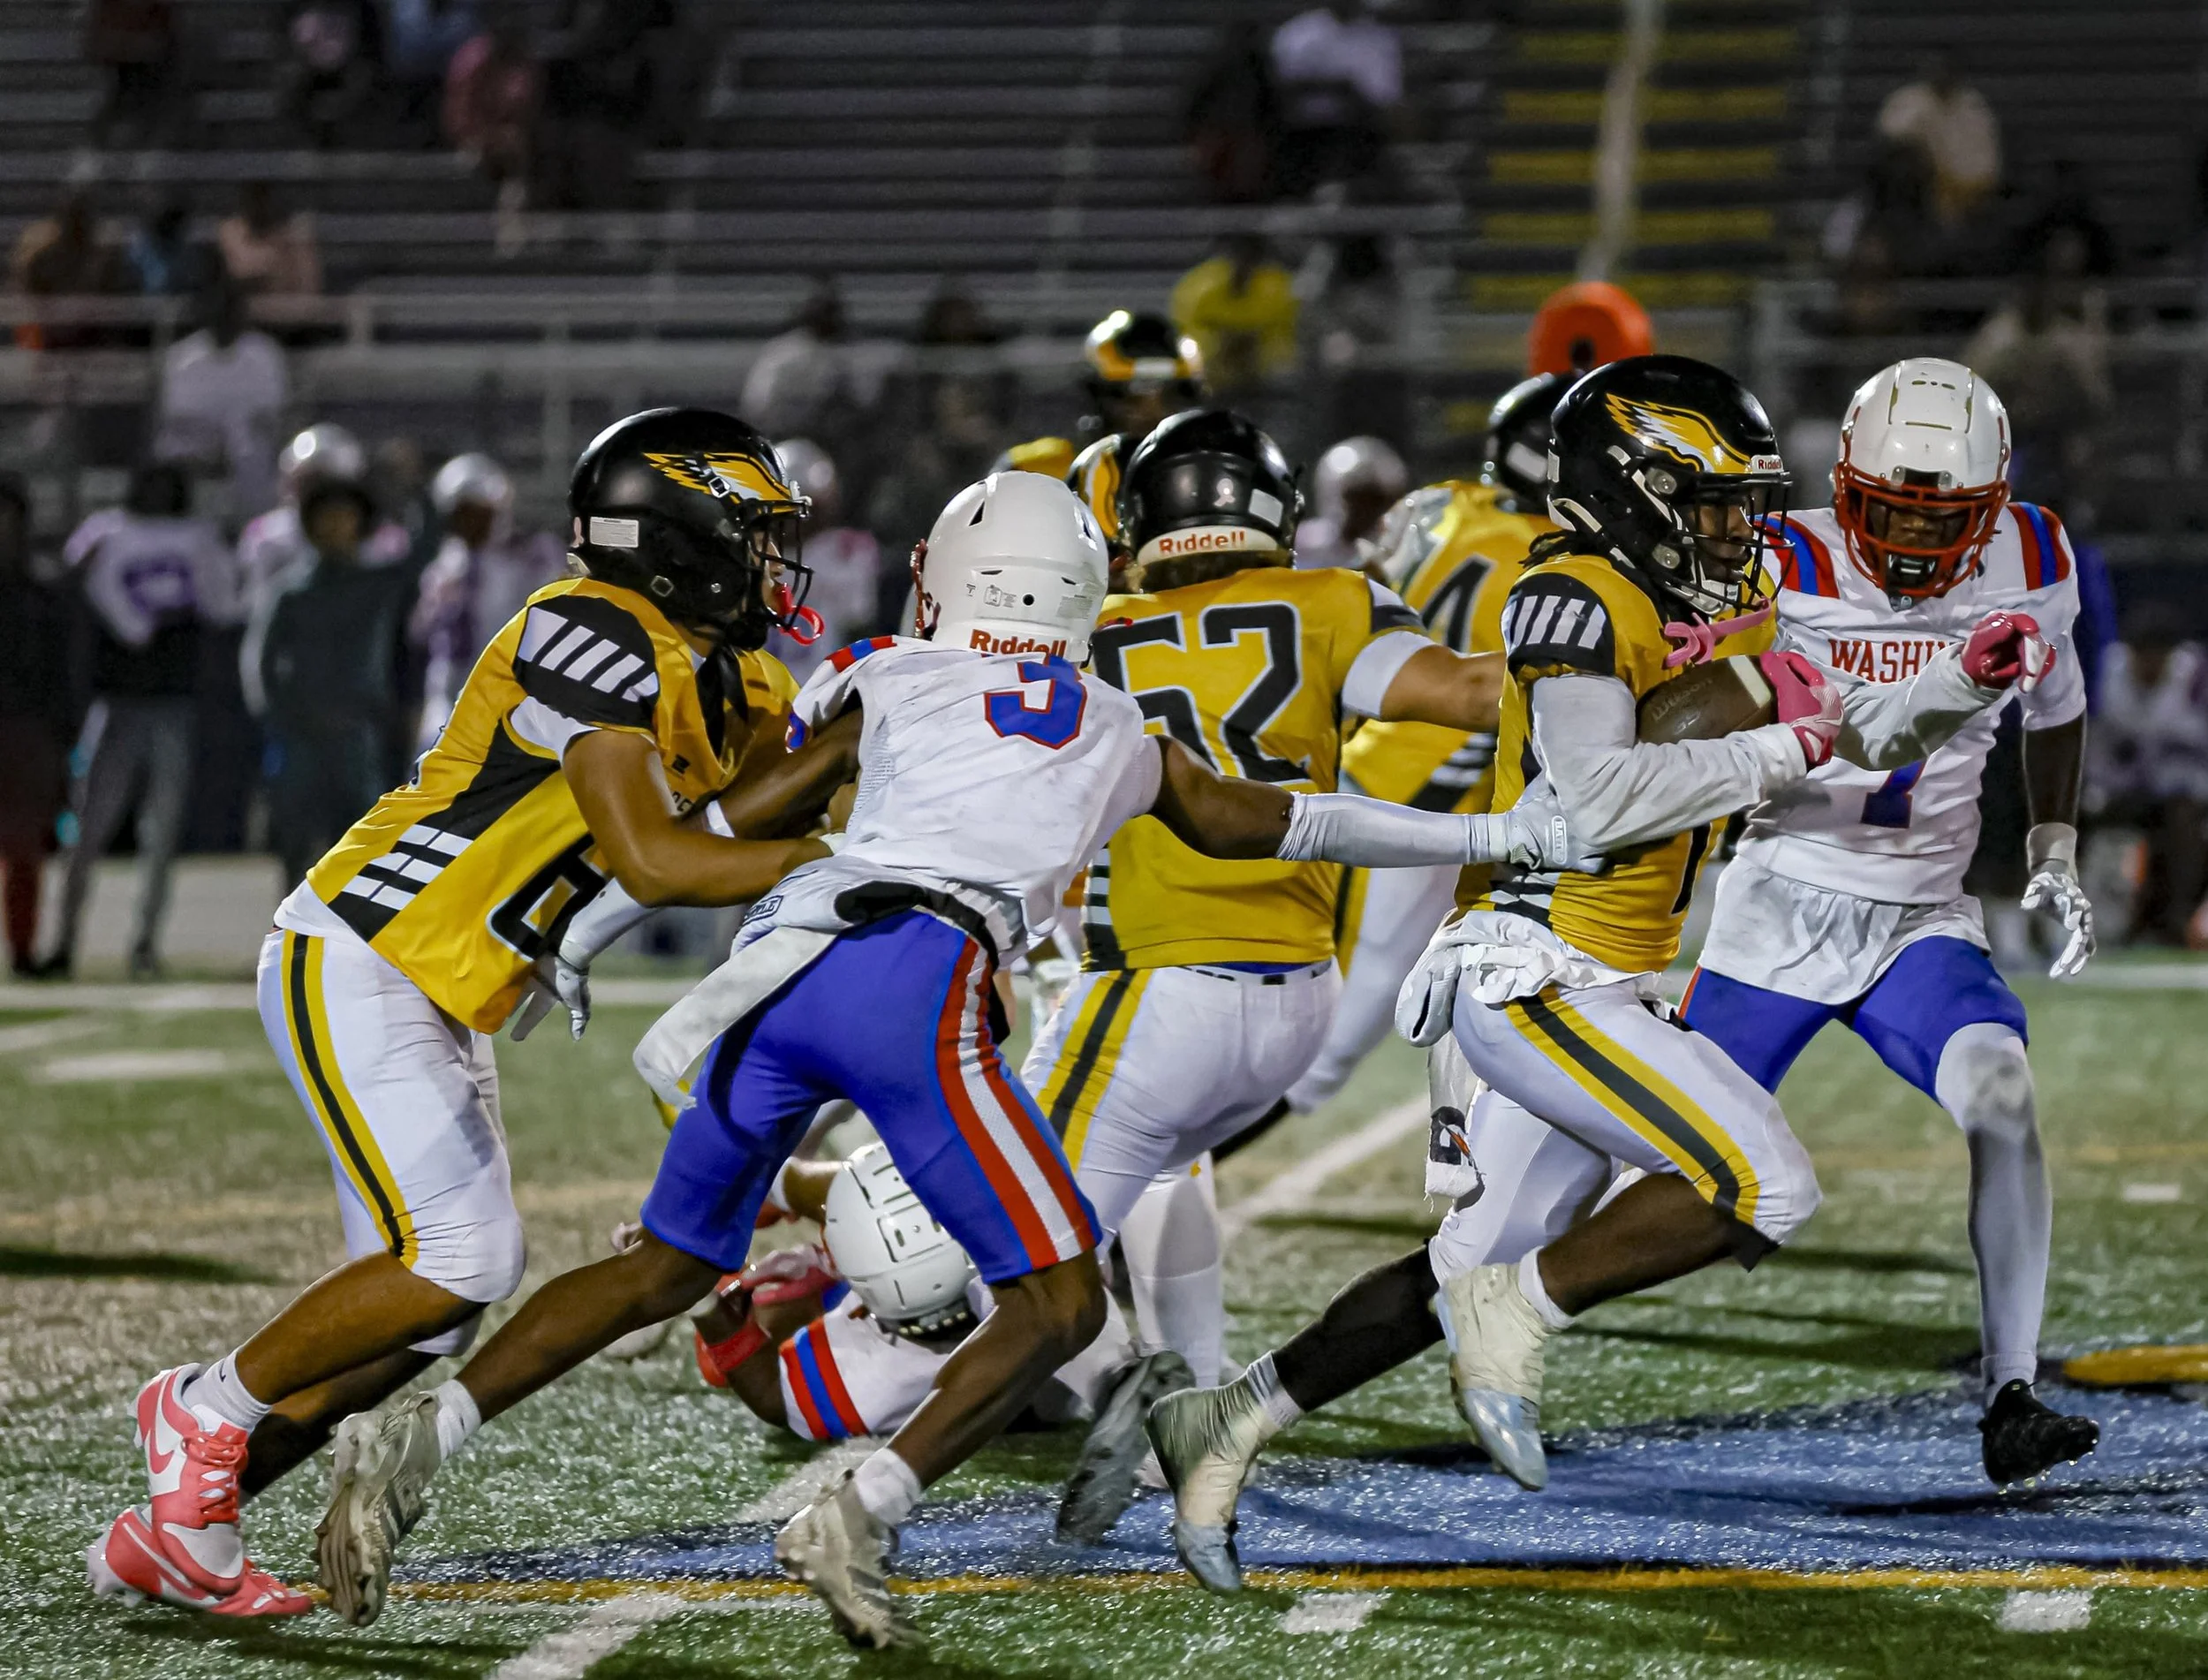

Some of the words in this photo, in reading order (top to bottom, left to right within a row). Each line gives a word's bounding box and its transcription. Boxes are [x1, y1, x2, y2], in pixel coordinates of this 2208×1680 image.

[1159, 530, 1246, 553] Riddell
[970, 628, 1068, 660] Riddell
[1827, 638, 1949, 685] WASHI
[1090, 601, 1312, 784] 52
